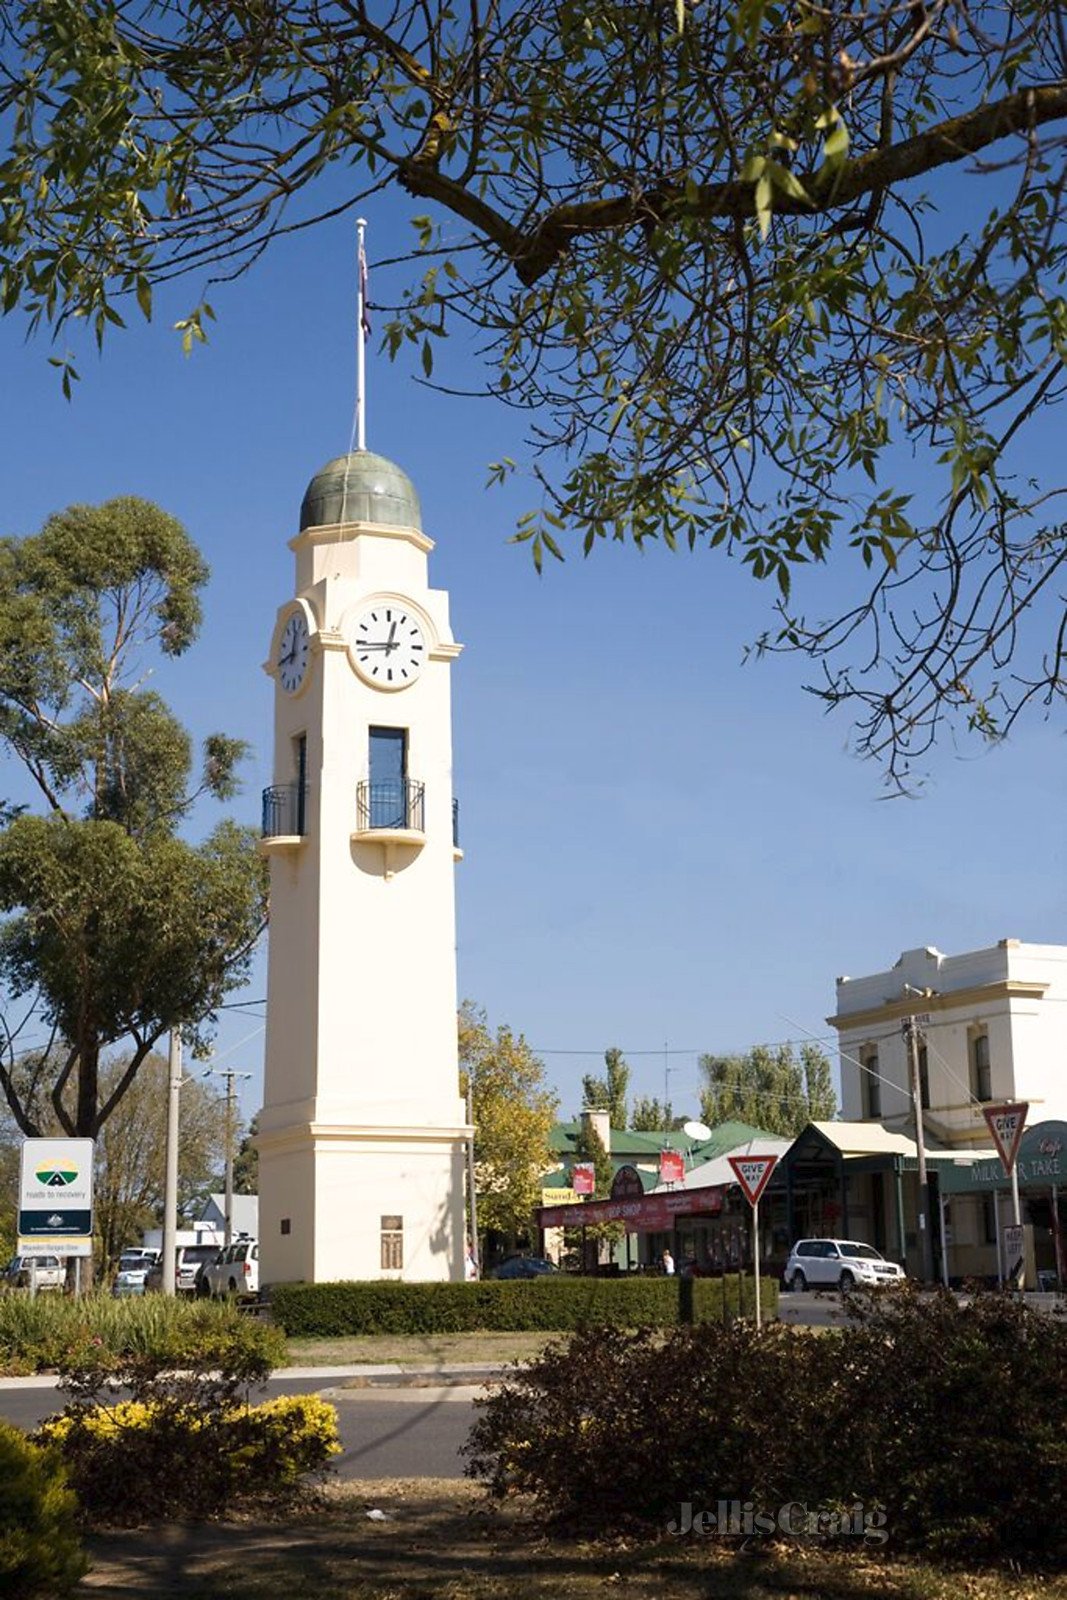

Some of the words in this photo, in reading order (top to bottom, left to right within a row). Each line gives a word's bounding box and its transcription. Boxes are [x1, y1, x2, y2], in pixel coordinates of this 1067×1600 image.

[996, 1116, 1016, 1131] GIVE
[741, 1163, 764, 1173] GIVE
[971, 1166, 998, 1183] MILK
[1031, 1158, 1061, 1176] TAKE
[47, 1191, 55, 1199] to
[56, 1191, 85, 1200] recovery
